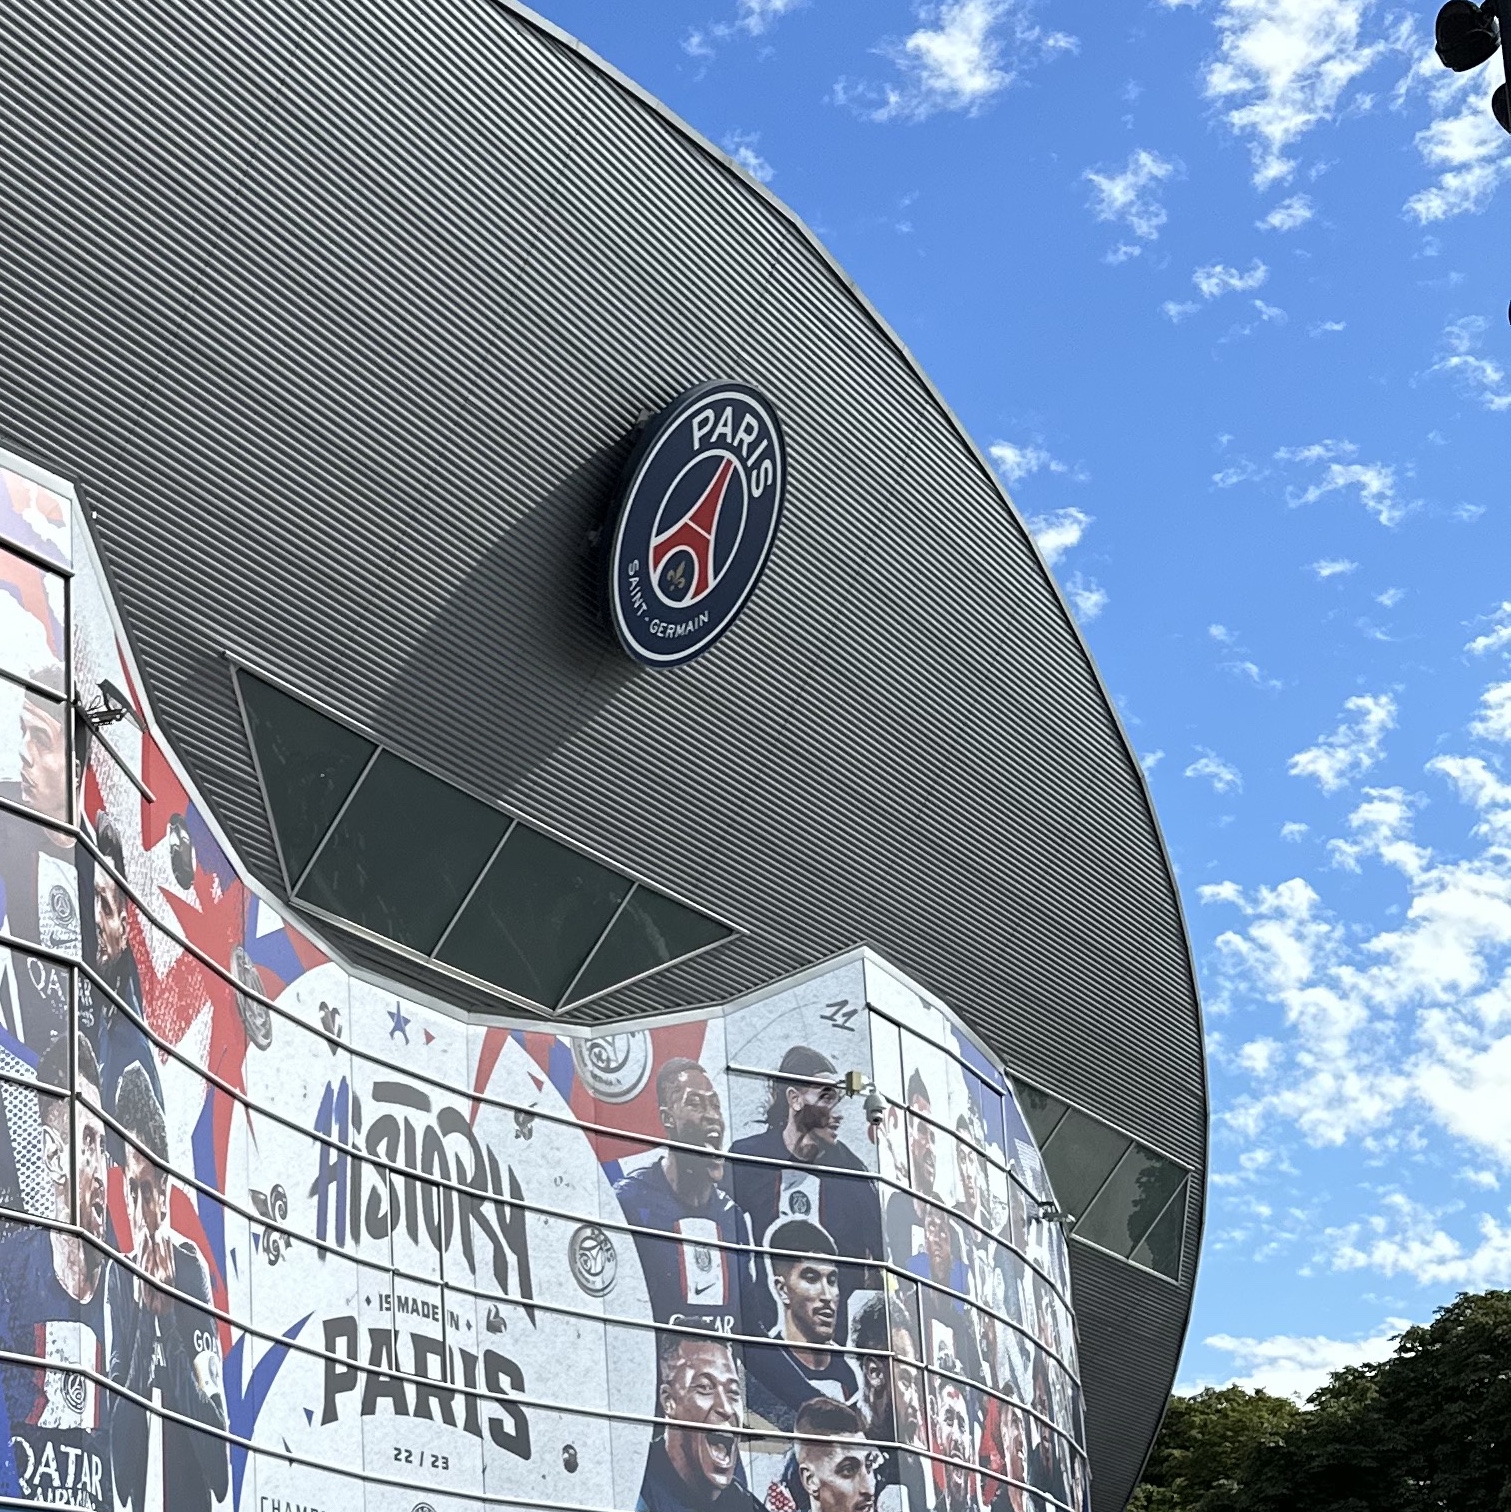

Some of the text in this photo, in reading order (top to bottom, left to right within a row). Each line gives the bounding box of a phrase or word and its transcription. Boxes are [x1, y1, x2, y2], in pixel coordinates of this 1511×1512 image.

[692, 405, 773, 498] PARIS
[627, 559, 710, 639] SAINT GERMAIN
[309, 1075, 538, 1330] HISTORY
[396, 1295, 440, 1323] MADE
[320, 1315, 532, 1461] PARIS
[393, 1447, 413, 1464] 22
[430, 1453, 450, 1471] 23
